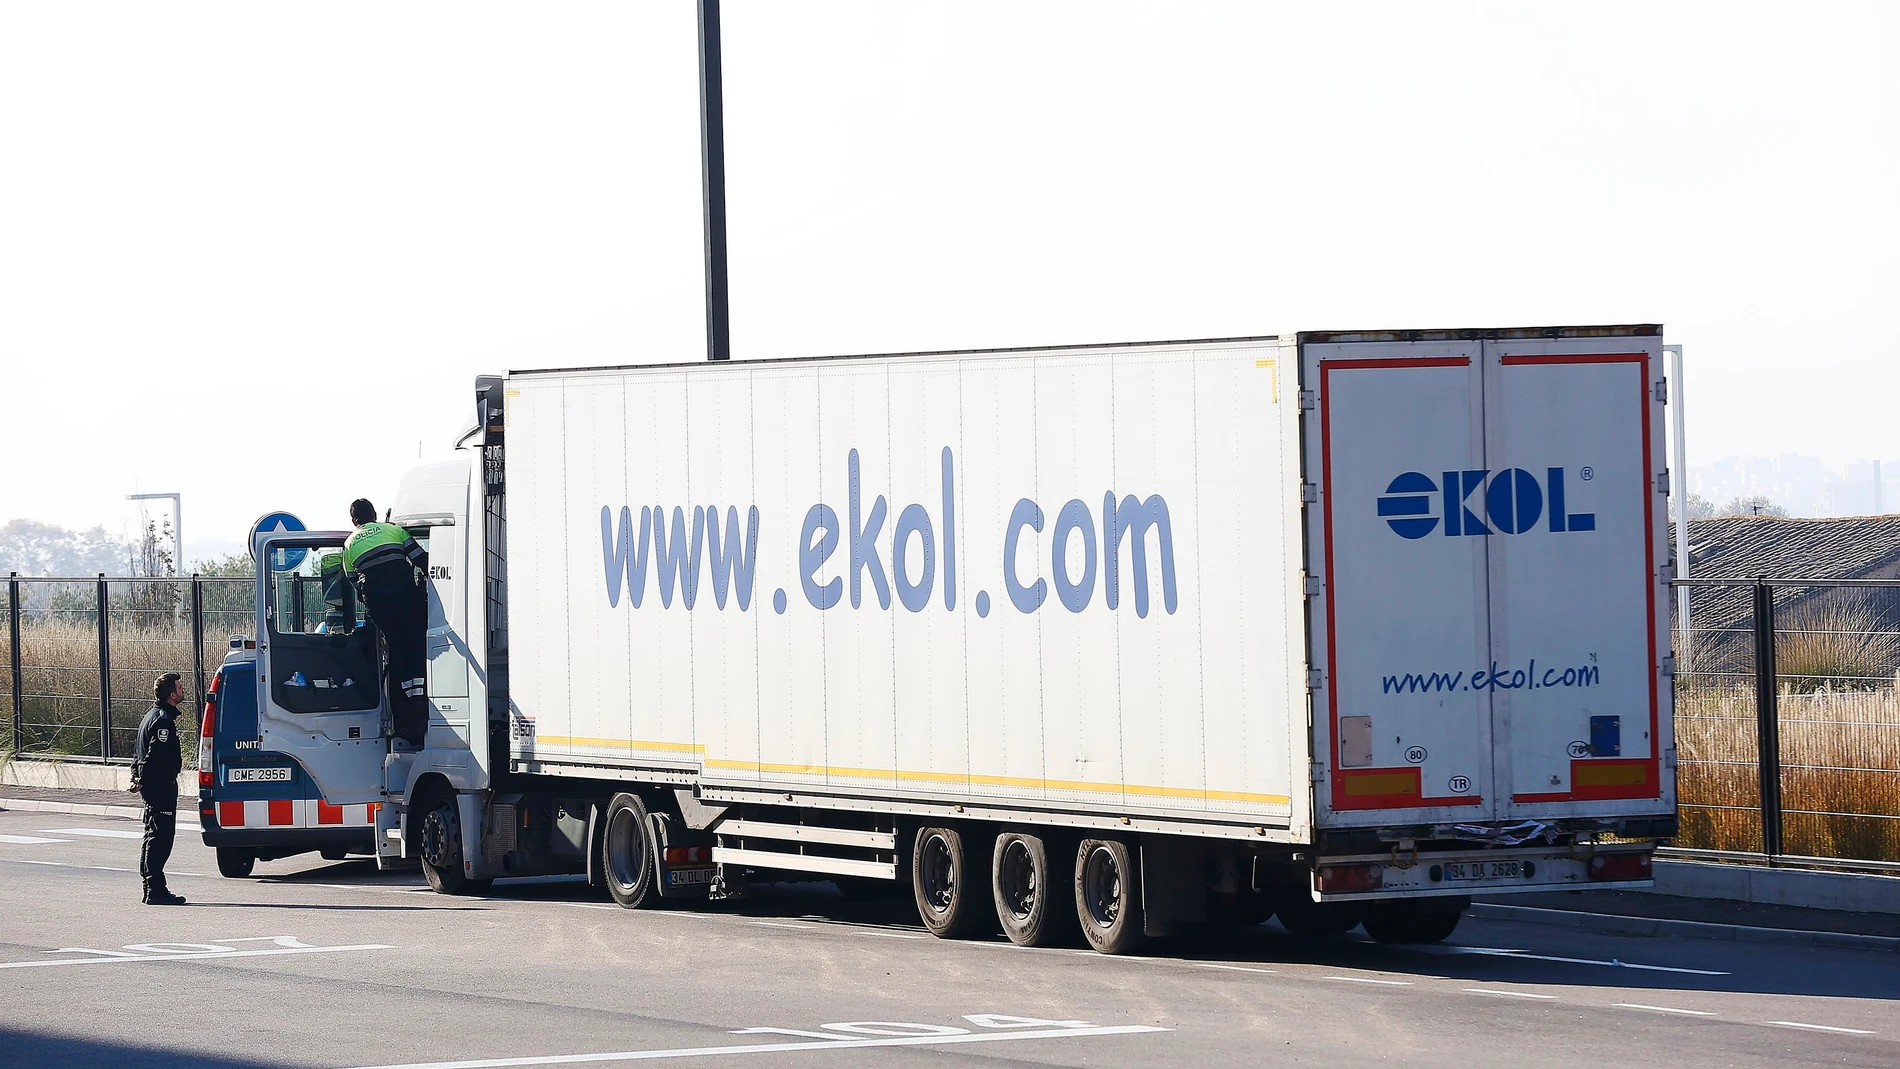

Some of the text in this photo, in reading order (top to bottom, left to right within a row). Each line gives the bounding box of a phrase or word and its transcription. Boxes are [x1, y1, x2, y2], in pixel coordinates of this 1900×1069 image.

[1377, 467, 1596, 539] EKOL
[601, 446, 1178, 620] www.ekol.com
[1382, 658, 1600, 695] www.ekol.com
[1410, 750, 1422, 760] 80
[234, 769, 286, 780] CME 2956
[1453, 779, 1467, 789] TR
[671, 871, 684, 884] 34
[688, 870, 700, 882] DL
[1452, 865, 1465, 878] 34
